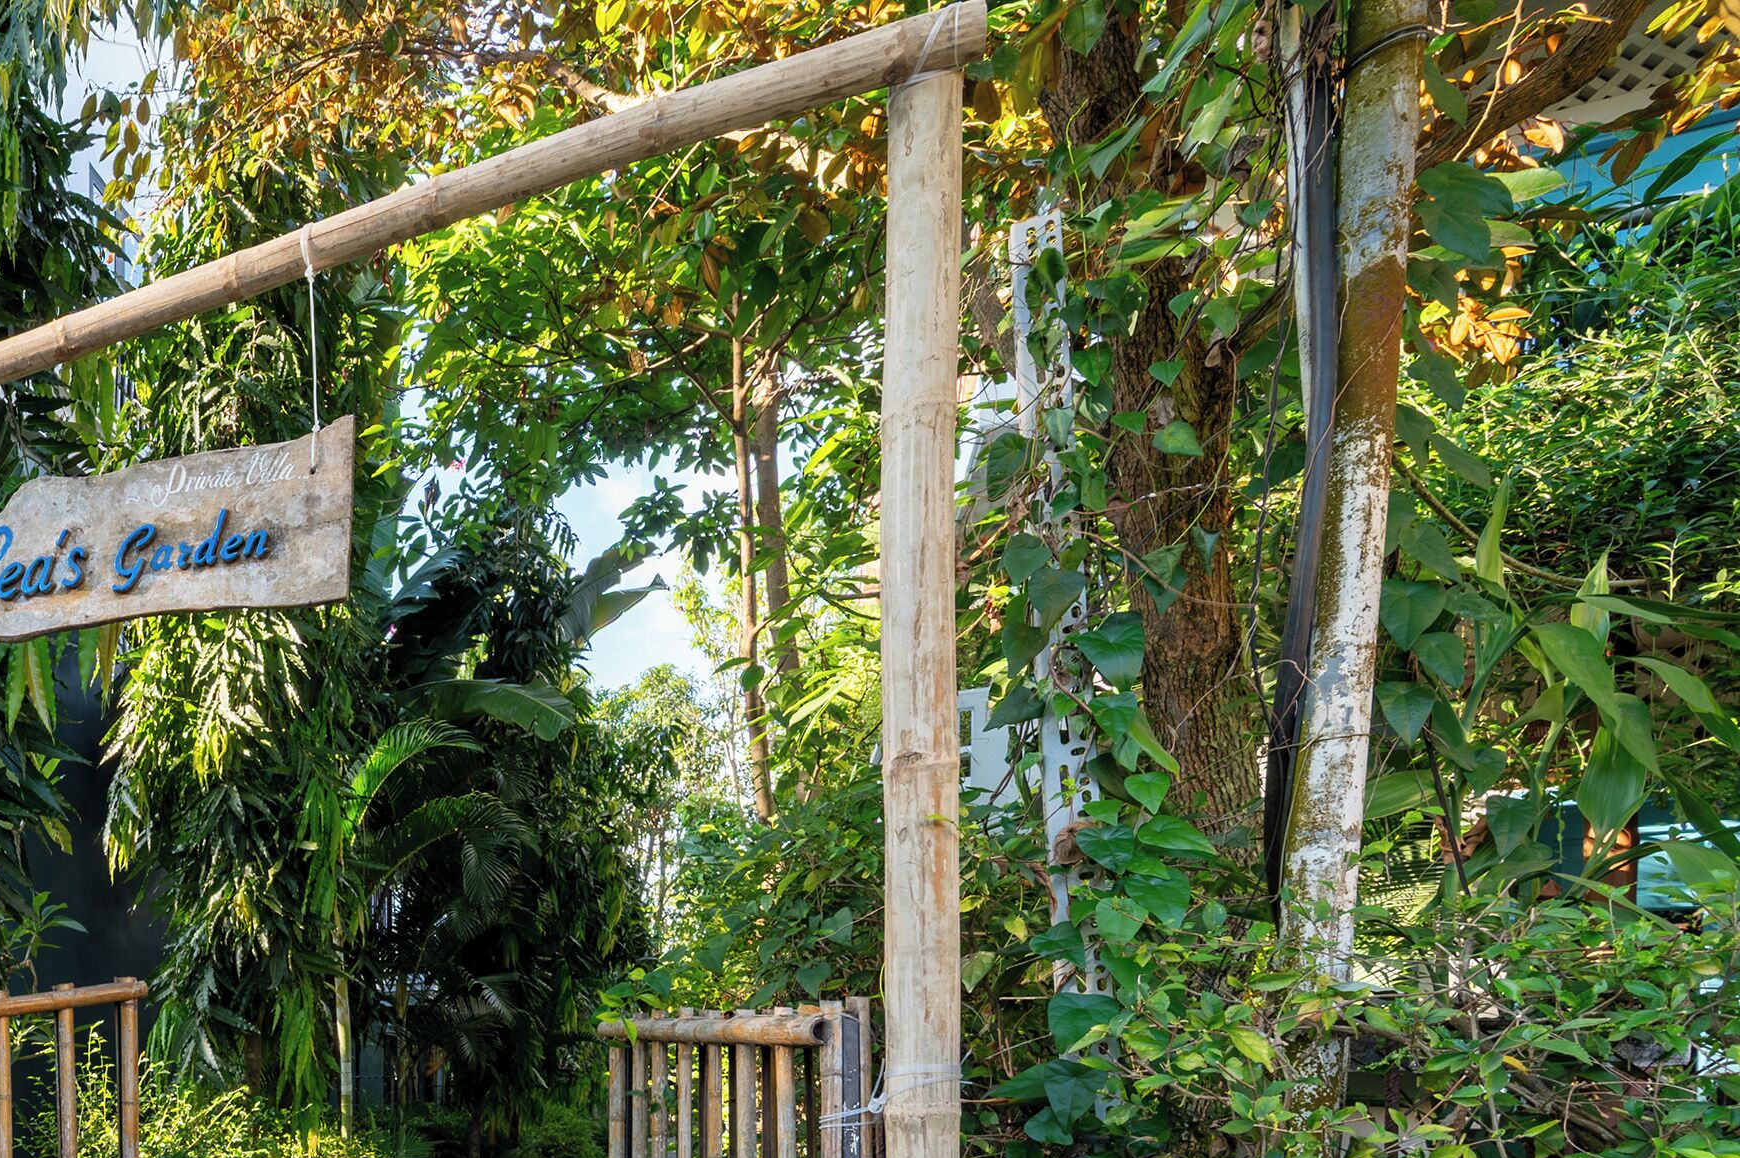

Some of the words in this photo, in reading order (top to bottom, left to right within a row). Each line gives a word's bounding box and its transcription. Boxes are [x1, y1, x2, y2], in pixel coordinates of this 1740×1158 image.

[151, 463, 237, 507] Private
[245, 451, 297, 485] Villa
[112, 508, 268, 593] Garden
